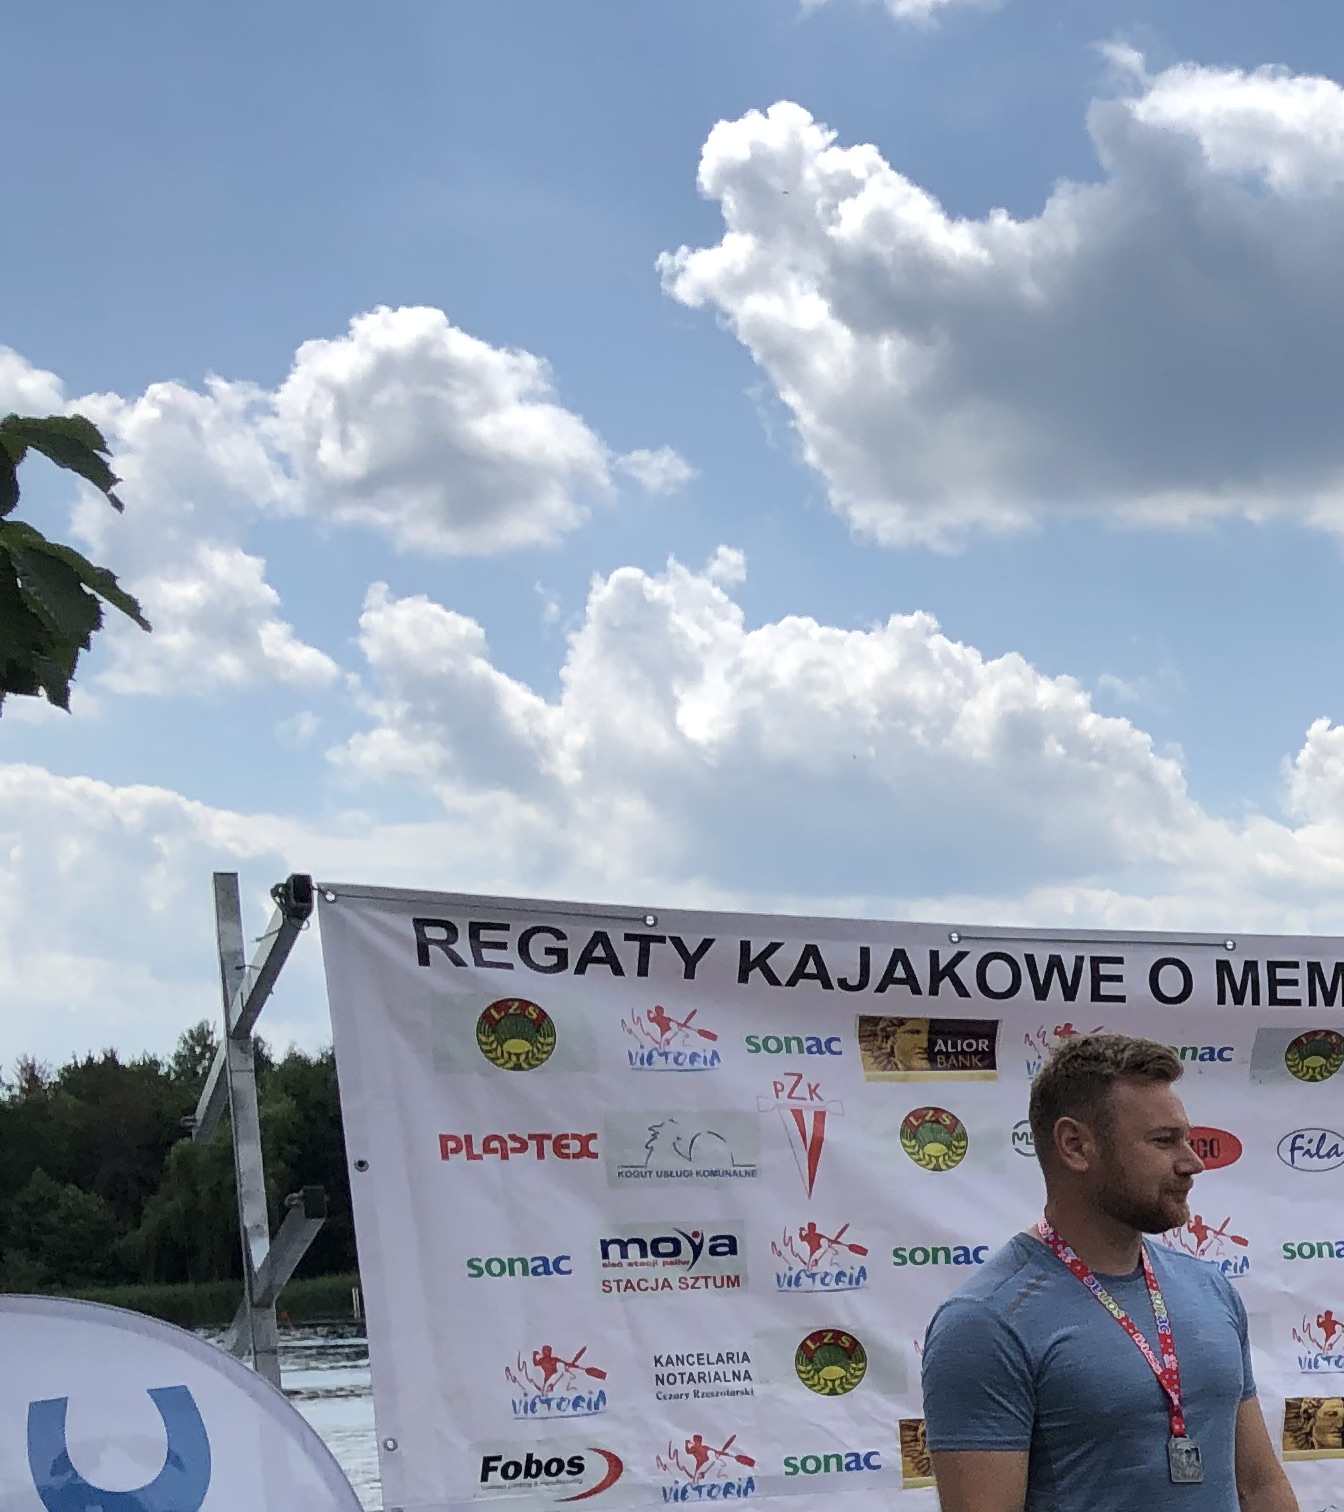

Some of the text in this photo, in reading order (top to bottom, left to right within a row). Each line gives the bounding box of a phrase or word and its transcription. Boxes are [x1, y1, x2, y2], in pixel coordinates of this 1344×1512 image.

[413, 917, 716, 980] REGATY
[737, 939, 1126, 1003] KAJAKOWE
[1149, 957, 1193, 1005] O
[745, 1034, 843, 1056] sonac
[934, 1039, 989, 1053] ALIOR
[1170, 1045, 1235, 1062] nac
[937, 1055, 983, 1068] BANK
[772, 1072, 825, 1101] PZK
[910, 1110, 953, 1126] LZS
[439, 1133, 599, 1160] PLASTEX
[600, 1228, 738, 1271] moya
[893, 1245, 989, 1266] sonac
[467, 1255, 572, 1278] sonac
[602, 1275, 741, 1293] STACJA SZTUM
[806, 1332, 852, 1350] LZS
[654, 1351, 751, 1368] KANCELARIA
[655, 1371, 752, 1386] NOTARIALNA
[481, 1453, 585, 1482] Fobos
[784, 1451, 881, 1476] sonac
